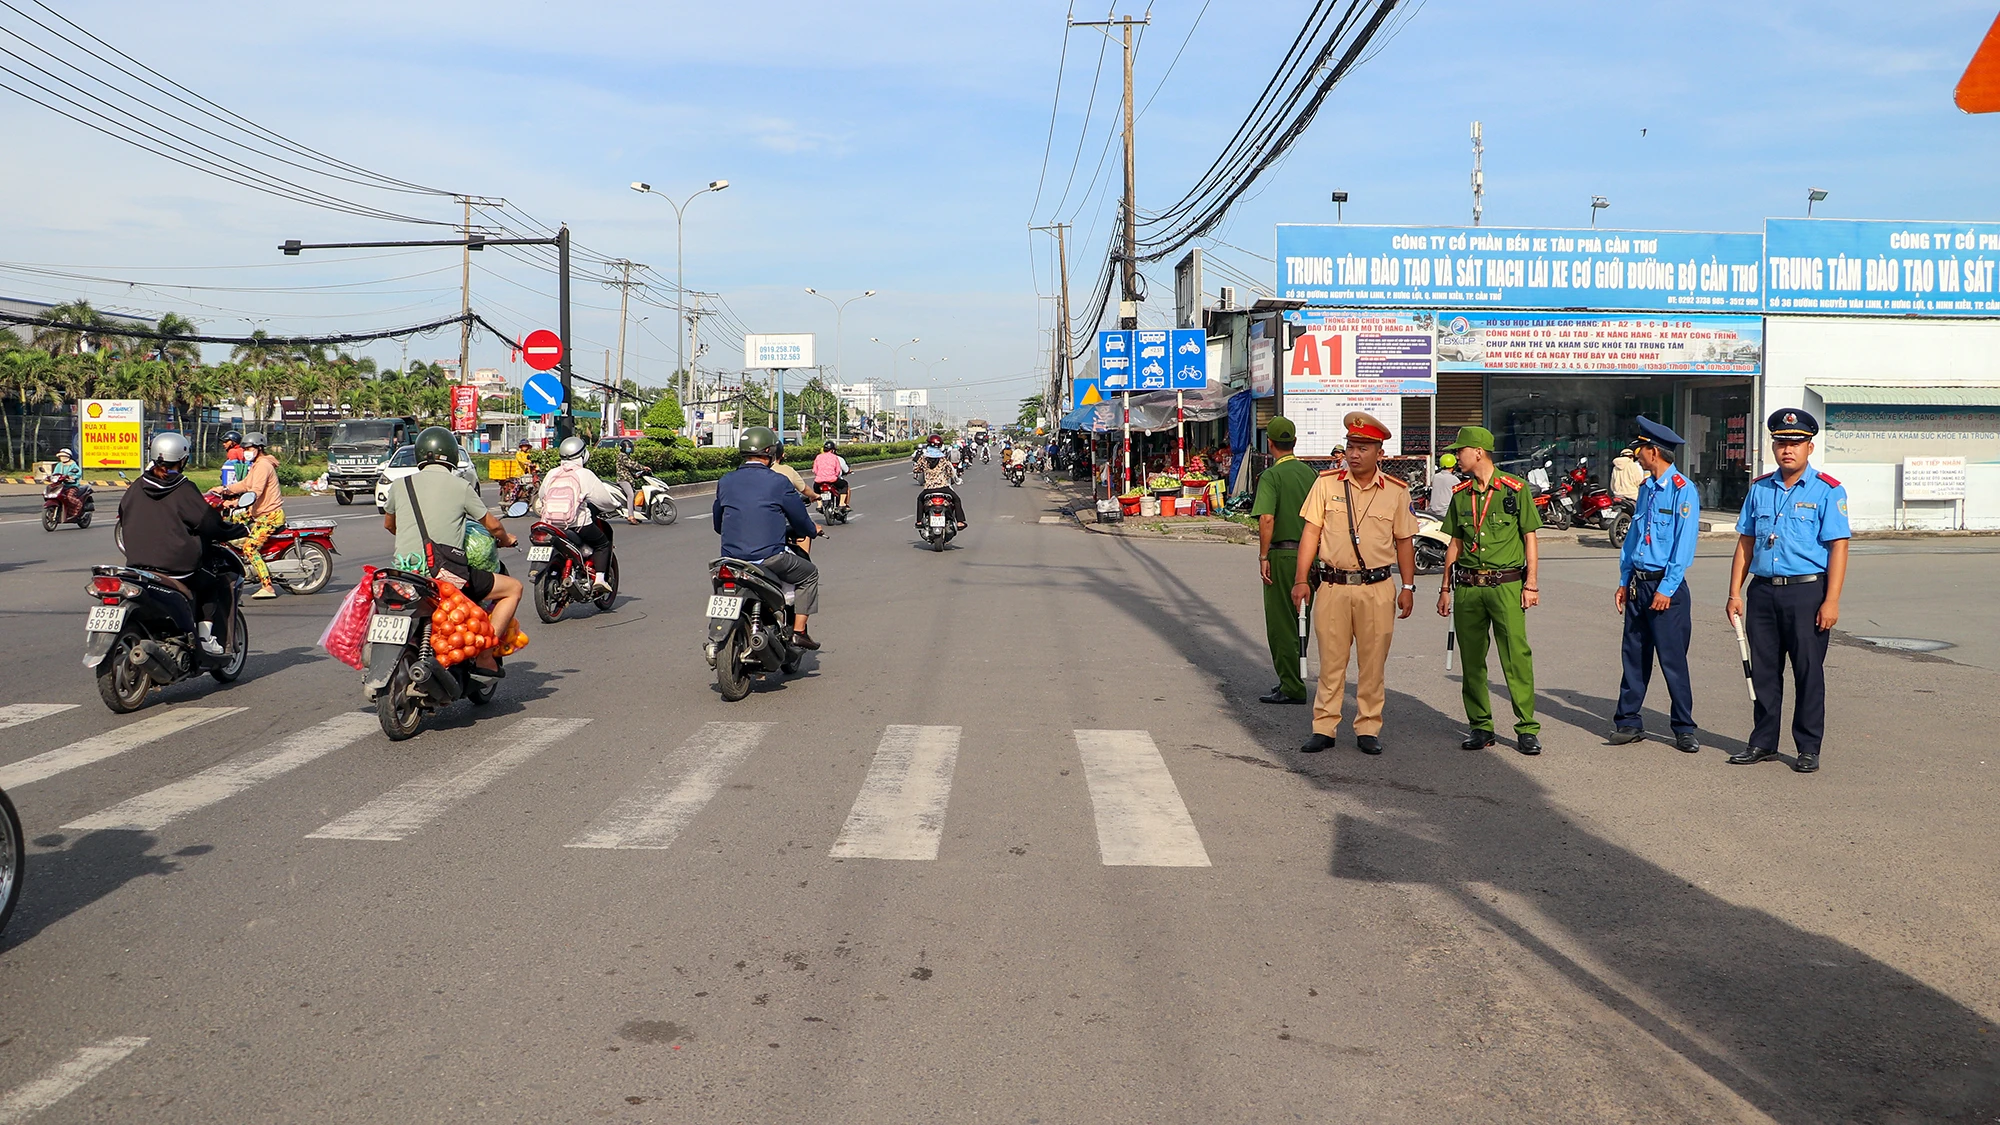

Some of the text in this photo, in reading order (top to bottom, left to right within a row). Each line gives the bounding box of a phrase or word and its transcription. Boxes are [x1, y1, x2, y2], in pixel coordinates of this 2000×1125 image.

[1392, 234, 1427, 249] CÔNG
[1430, 236, 1446, 250] TY
[1470, 233, 1502, 251] PHẦN
[1506, 233, 1529, 252] BẾN
[1533, 238, 1547, 252] XE
[1551, 236, 1574, 252] TÀU
[1578, 237, 1602, 252] PHÀ
[1605, 236, 1629, 253] CẦN
[1633, 238, 1658, 253] THƠ
[1890, 231, 1930, 249] CÔNG
[1934, 234, 1951, 249] TY
[1286, 252, 1758, 295] TRUNG TÂM ĐÀO TẠO VÀ SÁT HẠCH LÁI XE CƠ GIỚI ĐƯỜNG BỘ CẦN THƠ
[1770, 252, 1994, 298] TRUNG TÂM ĐÀO TẠO VÀ SÁT
[1770, 296, 1780, 307] SỐ
[1782, 298, 1791, 307] 36
[1884, 300, 1889, 308] P.
[1927, 301, 1934, 310] Q.
[1291, 335, 1342, 376] A1
[85, 433, 116, 443] THANH
[713, 597, 737, 607] 65-X3
[95, 608, 119, 618] 65-B1
[711, 607, 735, 616] 0257
[88, 619, 120, 630] 587.88
[377, 617, 404, 629] 65-D1
[372, 629, 405, 642] 144.44
